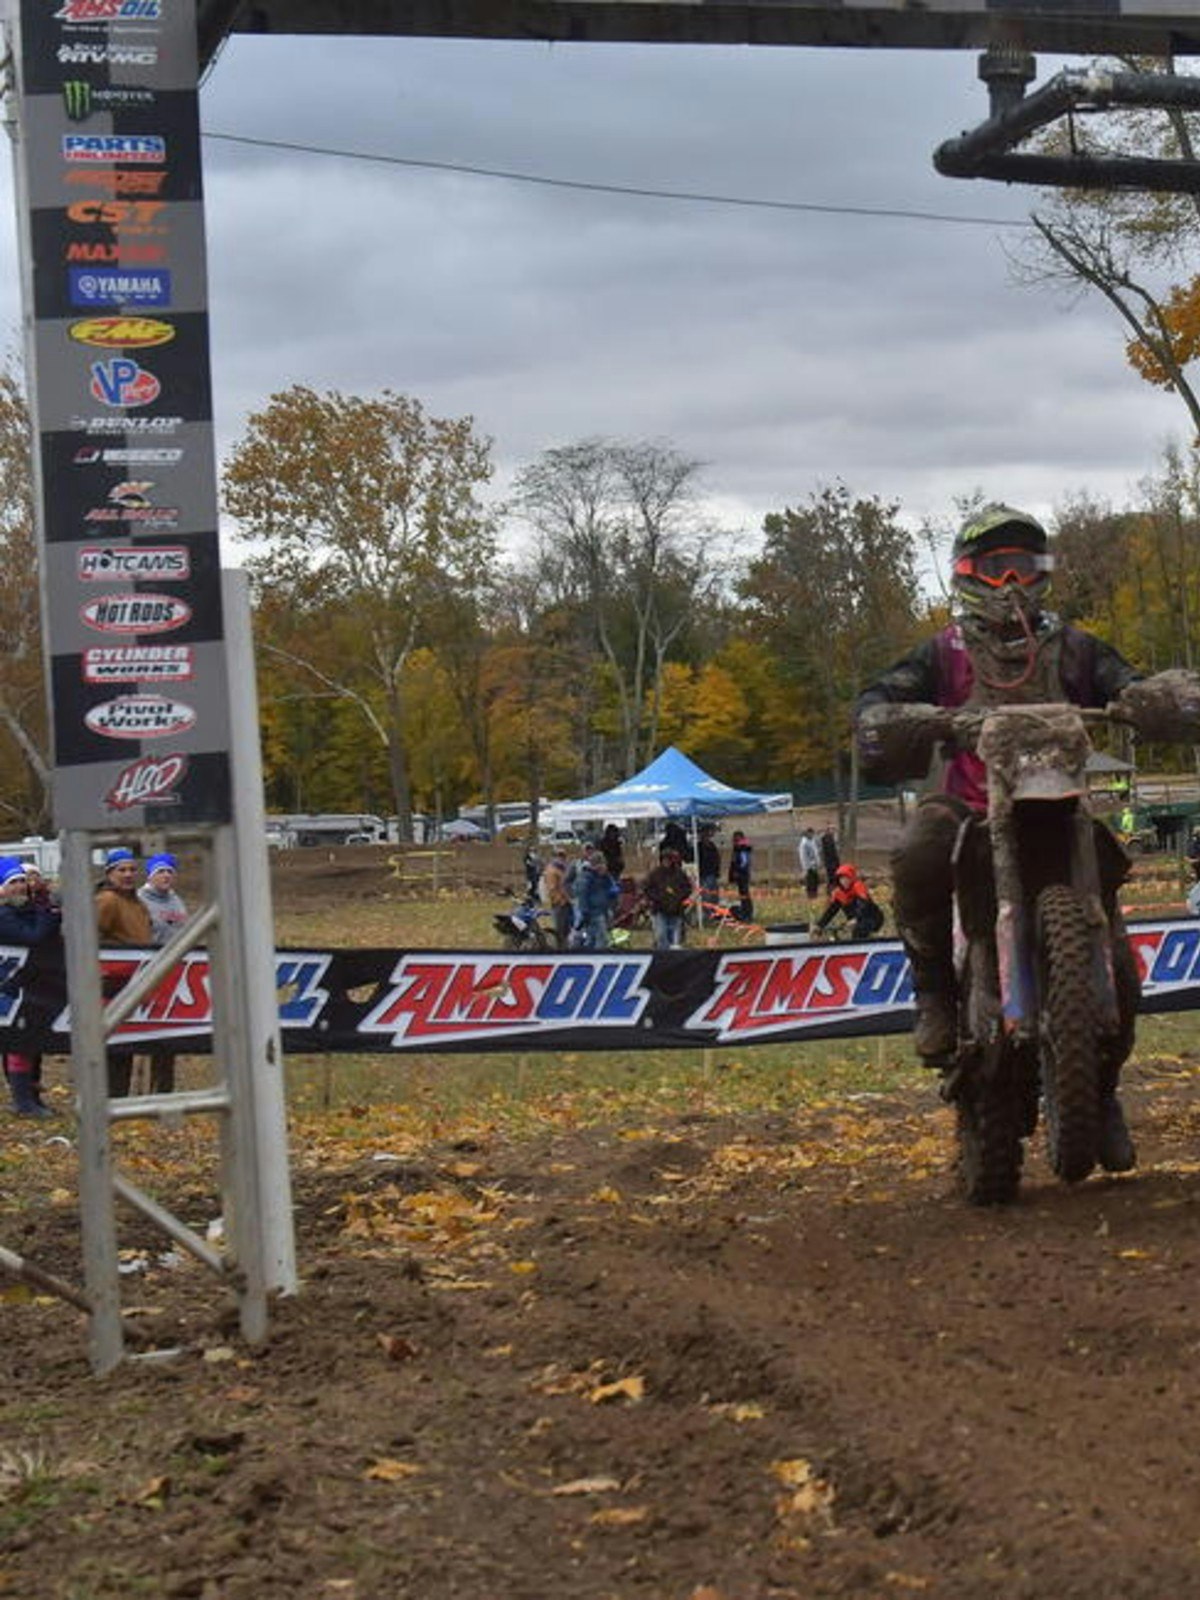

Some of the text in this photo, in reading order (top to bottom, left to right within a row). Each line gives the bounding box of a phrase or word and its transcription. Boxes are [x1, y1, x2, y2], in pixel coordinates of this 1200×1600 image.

[58, 0, 160, 20] AMSOIL
[66, 137, 162, 151] PARTS
[66, 200, 167, 223] CST
[66, 243, 164, 260] MAX
[98, 276, 161, 293] YAMAHA
[93, 359, 138, 405] VP
[91, 416, 183, 429] DUNLOP
[96, 602, 174, 623] HOT RODS
[87, 647, 189, 662] CYLINDER
[697, 948, 915, 1032] AMSO
[370, 960, 645, 1042] AMSOIL
